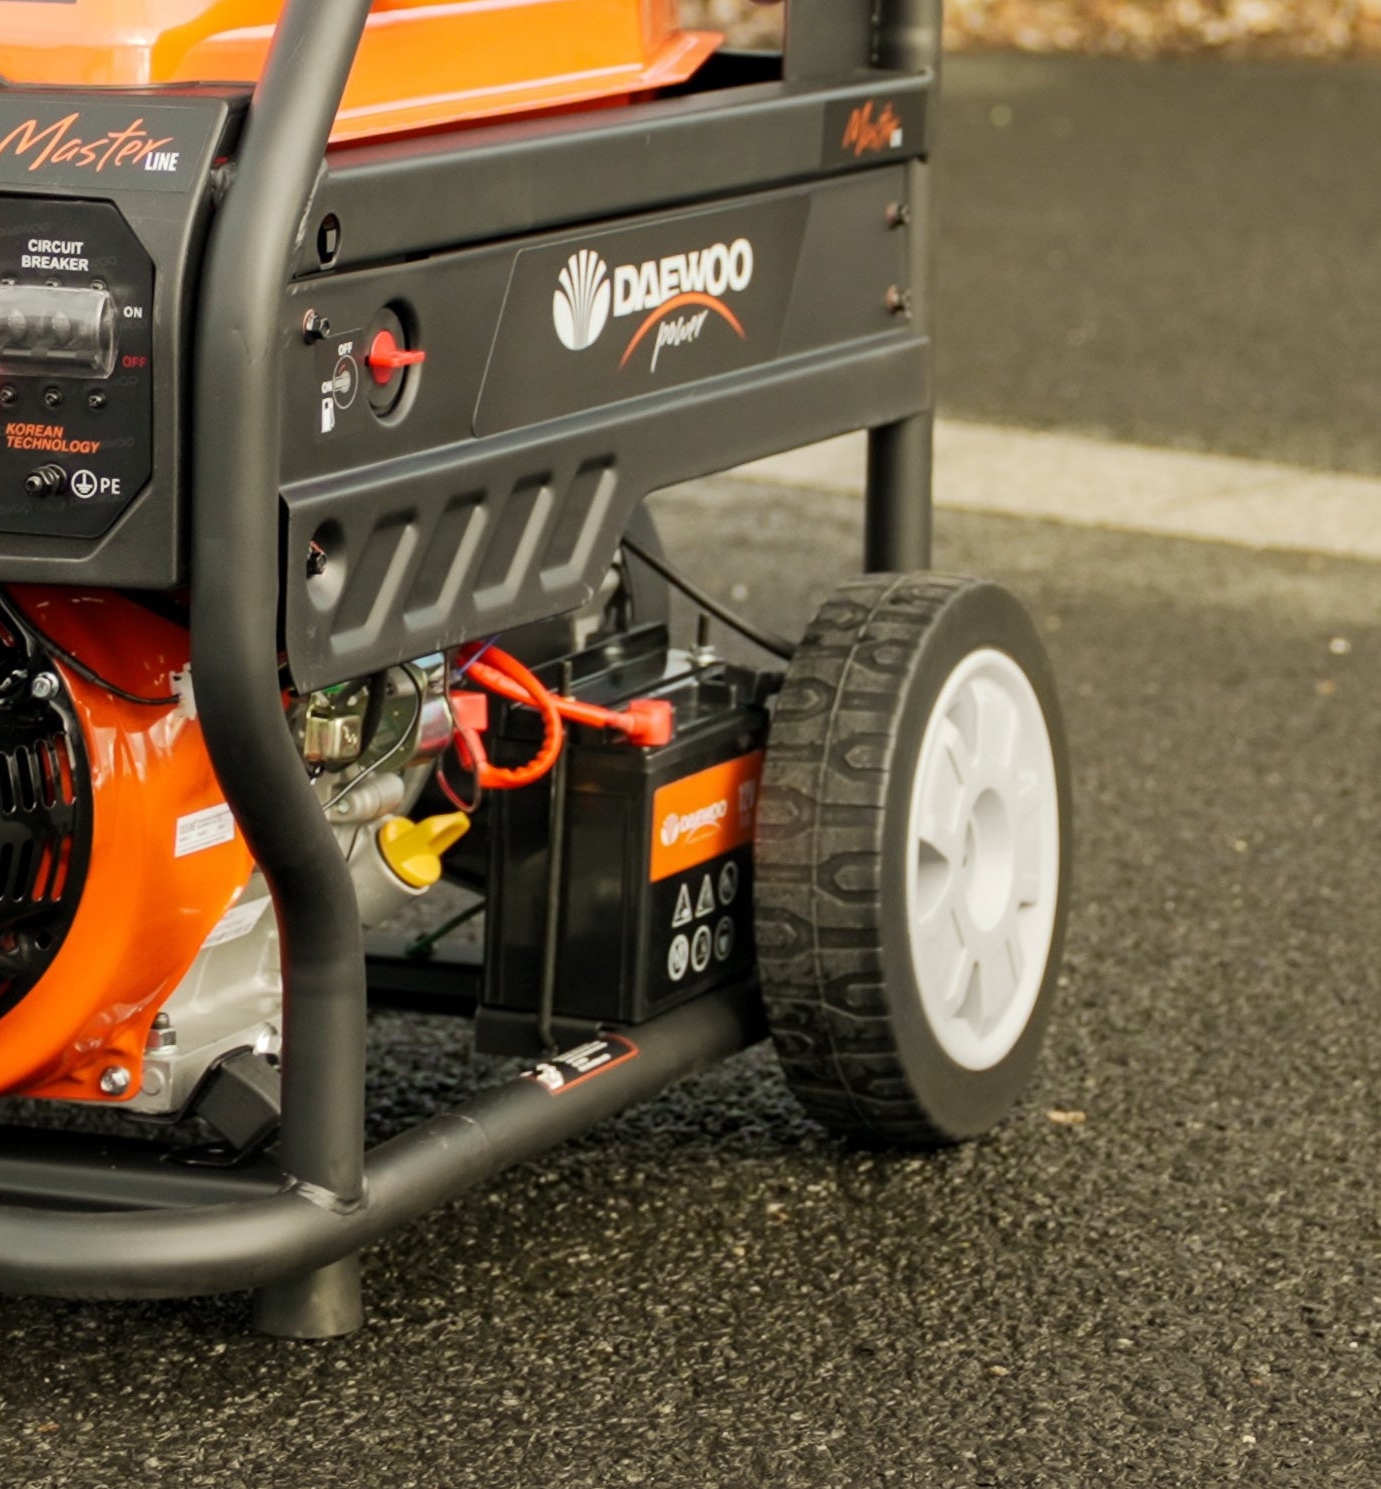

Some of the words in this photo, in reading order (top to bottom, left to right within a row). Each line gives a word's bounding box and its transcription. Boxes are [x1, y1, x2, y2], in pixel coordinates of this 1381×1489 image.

[144, 151, 180, 173] LINE
[27, 238, 84, 255] CIRCUIT
[20, 255, 90, 272] BREAKER
[613, 237, 754, 318] DAEWOO
[122, 306, 143, 319] ON
[338, 341, 354, 356] OFF
[122, 356, 147, 369] OFF
[5, 422, 65, 438] KOREAN
[6, 436, 101, 455] TECHNOLOGY
[99, 477, 121, 495] PE
